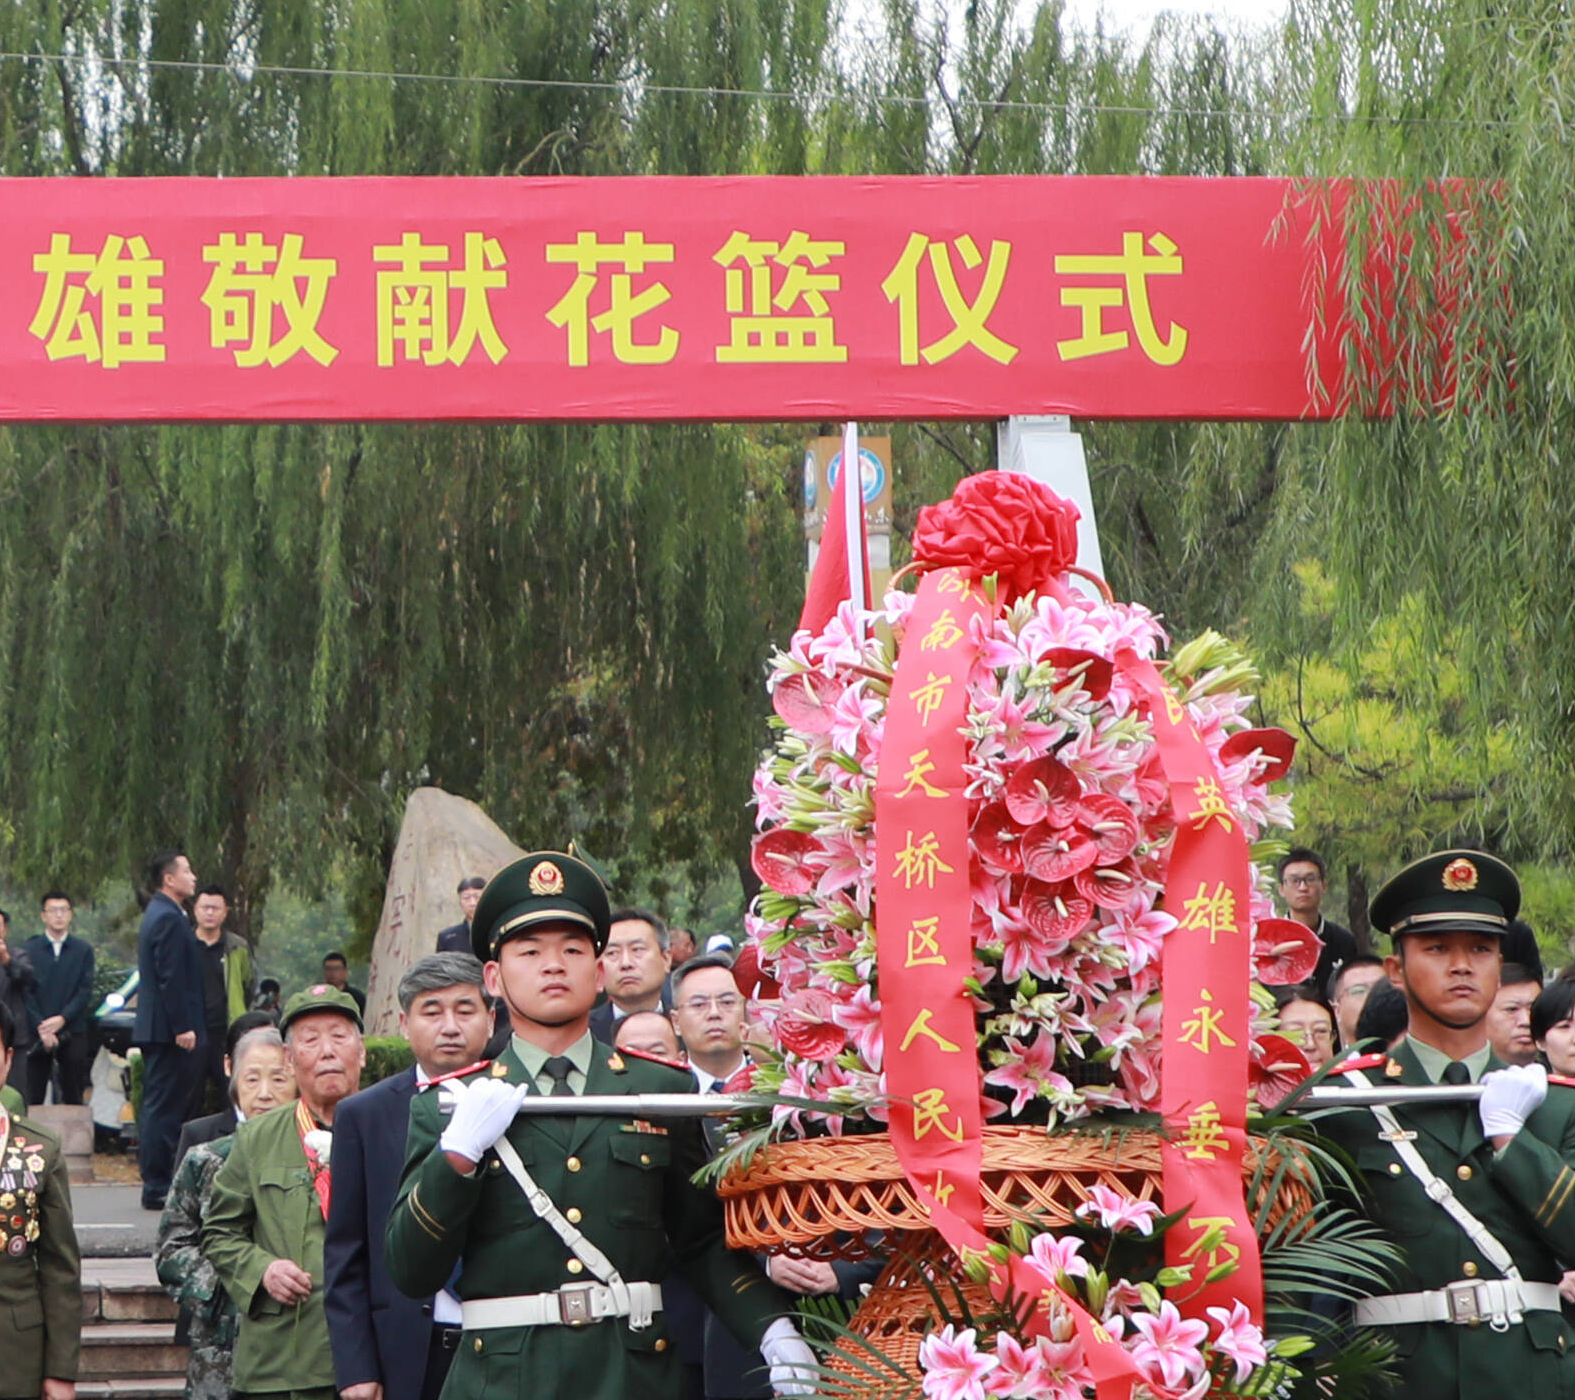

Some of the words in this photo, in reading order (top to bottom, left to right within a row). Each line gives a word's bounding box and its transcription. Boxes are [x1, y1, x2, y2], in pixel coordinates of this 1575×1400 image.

[1159, 685, 1241, 1363] 民英雄永垂不
